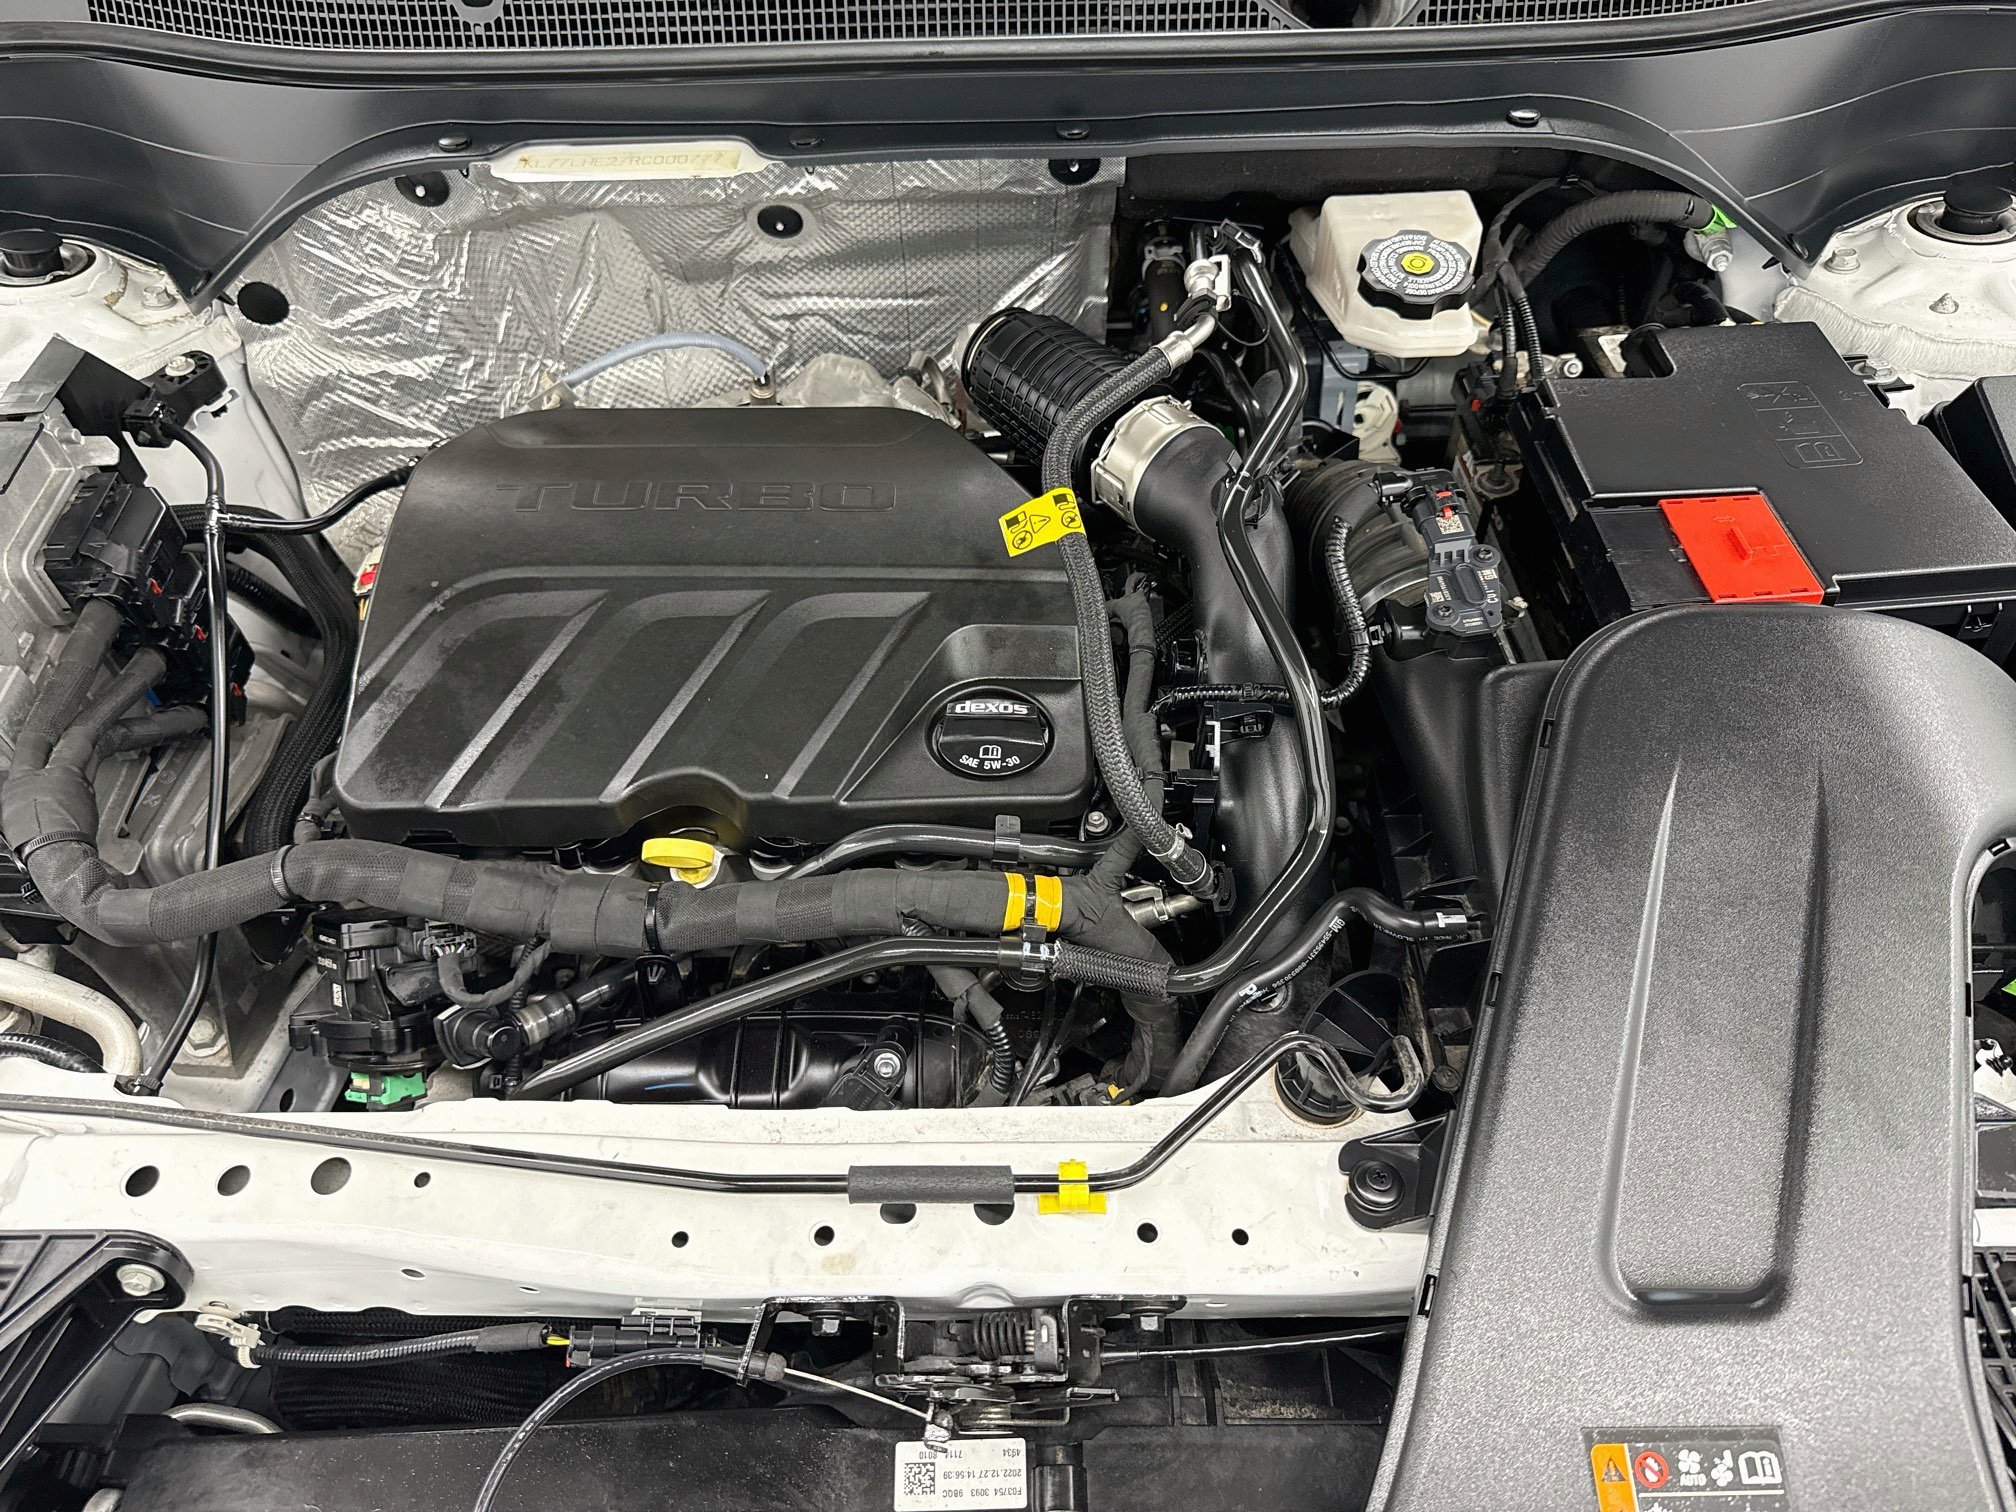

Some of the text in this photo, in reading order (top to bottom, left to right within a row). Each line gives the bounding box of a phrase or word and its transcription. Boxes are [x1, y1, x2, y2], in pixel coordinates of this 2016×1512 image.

[496, 481, 897, 512] TURBO
[955, 701, 1029, 714] dexos
[959, 754, 1020, 770] SAE 5W-30
[1002, 1448, 1021, 1458] 4934
[943, 1469, 1022, 1480] 2022.12.27 14:56:39
[1680, 1474, 1707, 1487] AUTO
[970, 1488, 989, 1497] 3093
[994, 1487, 1022, 1496] F03754
